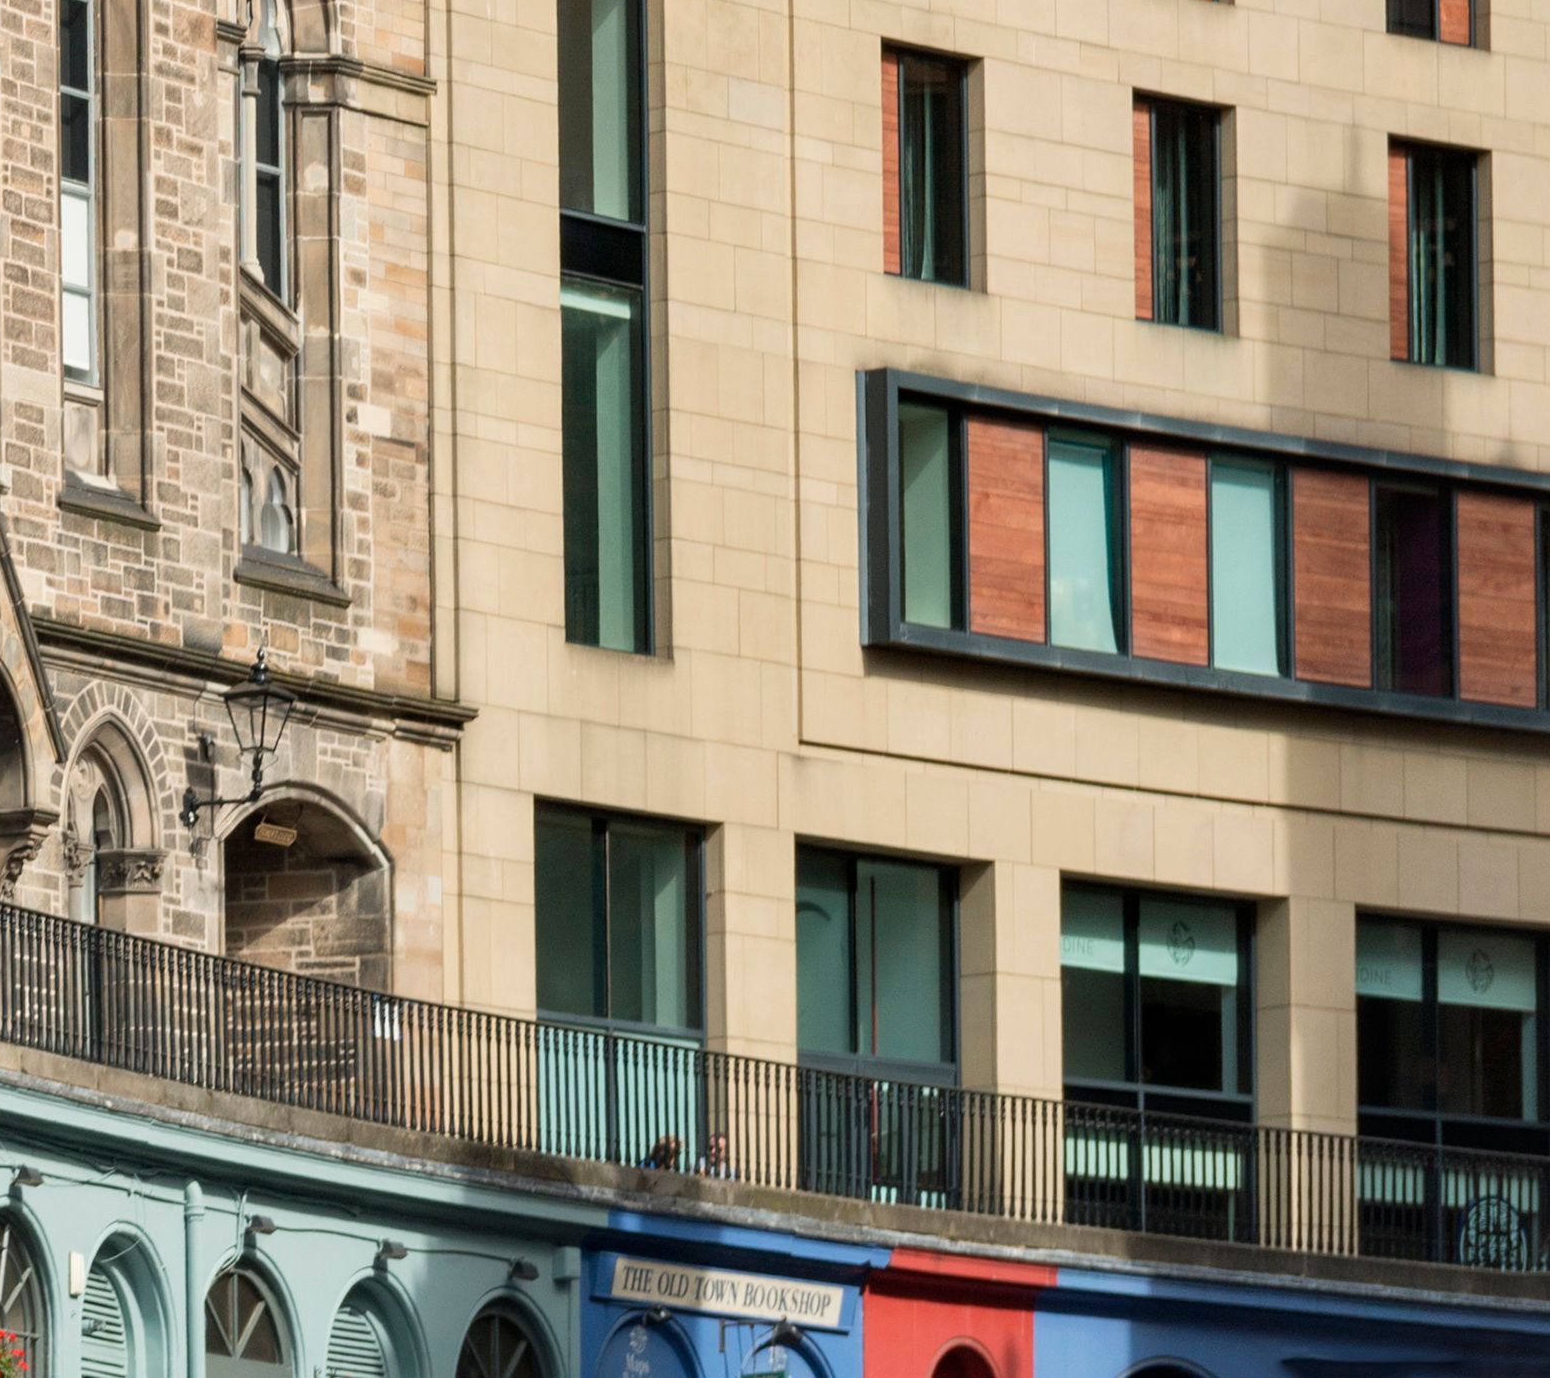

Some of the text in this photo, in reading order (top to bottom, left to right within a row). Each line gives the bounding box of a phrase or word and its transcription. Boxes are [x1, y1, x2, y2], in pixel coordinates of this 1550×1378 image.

[622, 1265, 832, 1318] THE OLD TOWN BOOKSHOP
